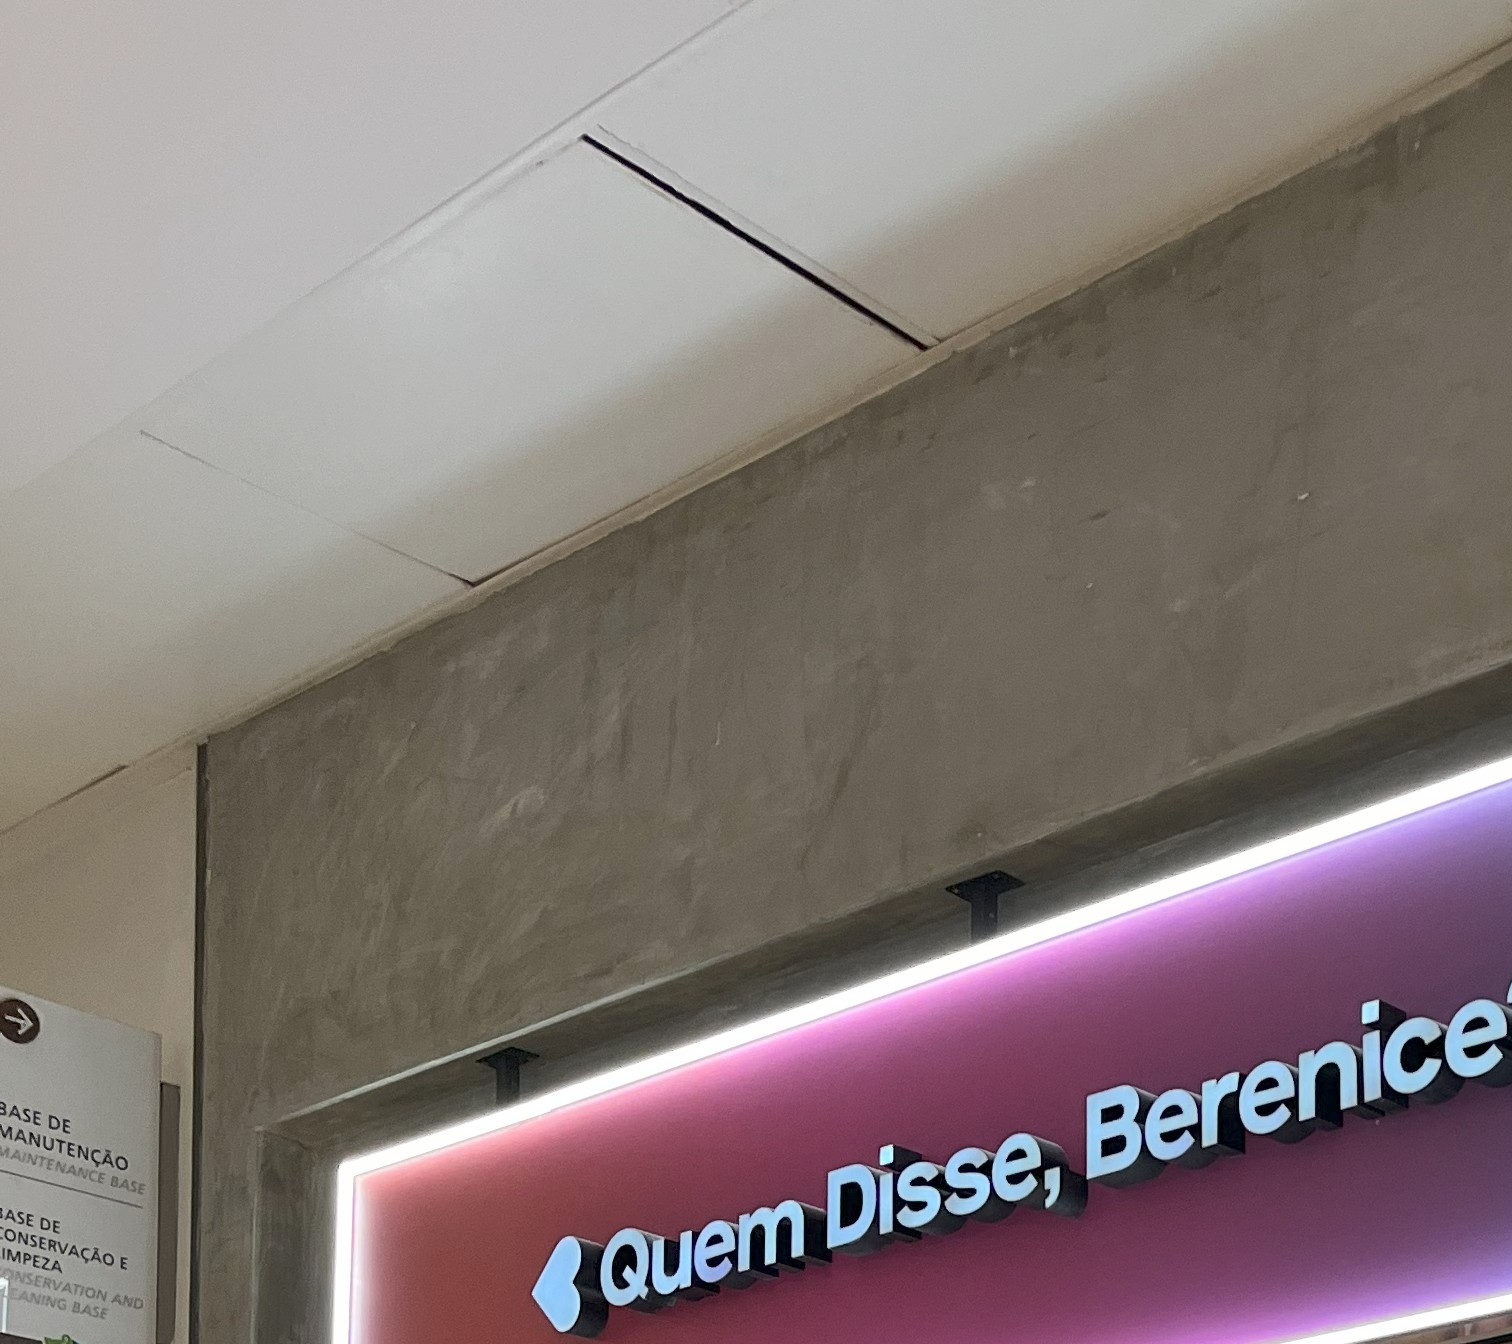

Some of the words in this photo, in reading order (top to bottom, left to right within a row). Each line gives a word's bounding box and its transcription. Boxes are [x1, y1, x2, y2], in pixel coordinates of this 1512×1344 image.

[48, 1114, 71, 1134] DE
[0, 1124, 129, 1170] MANUTENÇÃO
[110, 1175, 146, 1195] BASE
[40, 1217, 61, 1234] DE
[601, 1200, 803, 1306] Quem
[828, 1132, 1062, 1249] Disse,
[0, 1247, 63, 1274] IMPEZA
[120, 1256, 128, 1270] E
[0, 1267, 107, 1301] ONSERVATION
[111, 1293, 144, 1310] AND
[72, 1301, 109, 1320] BASE
